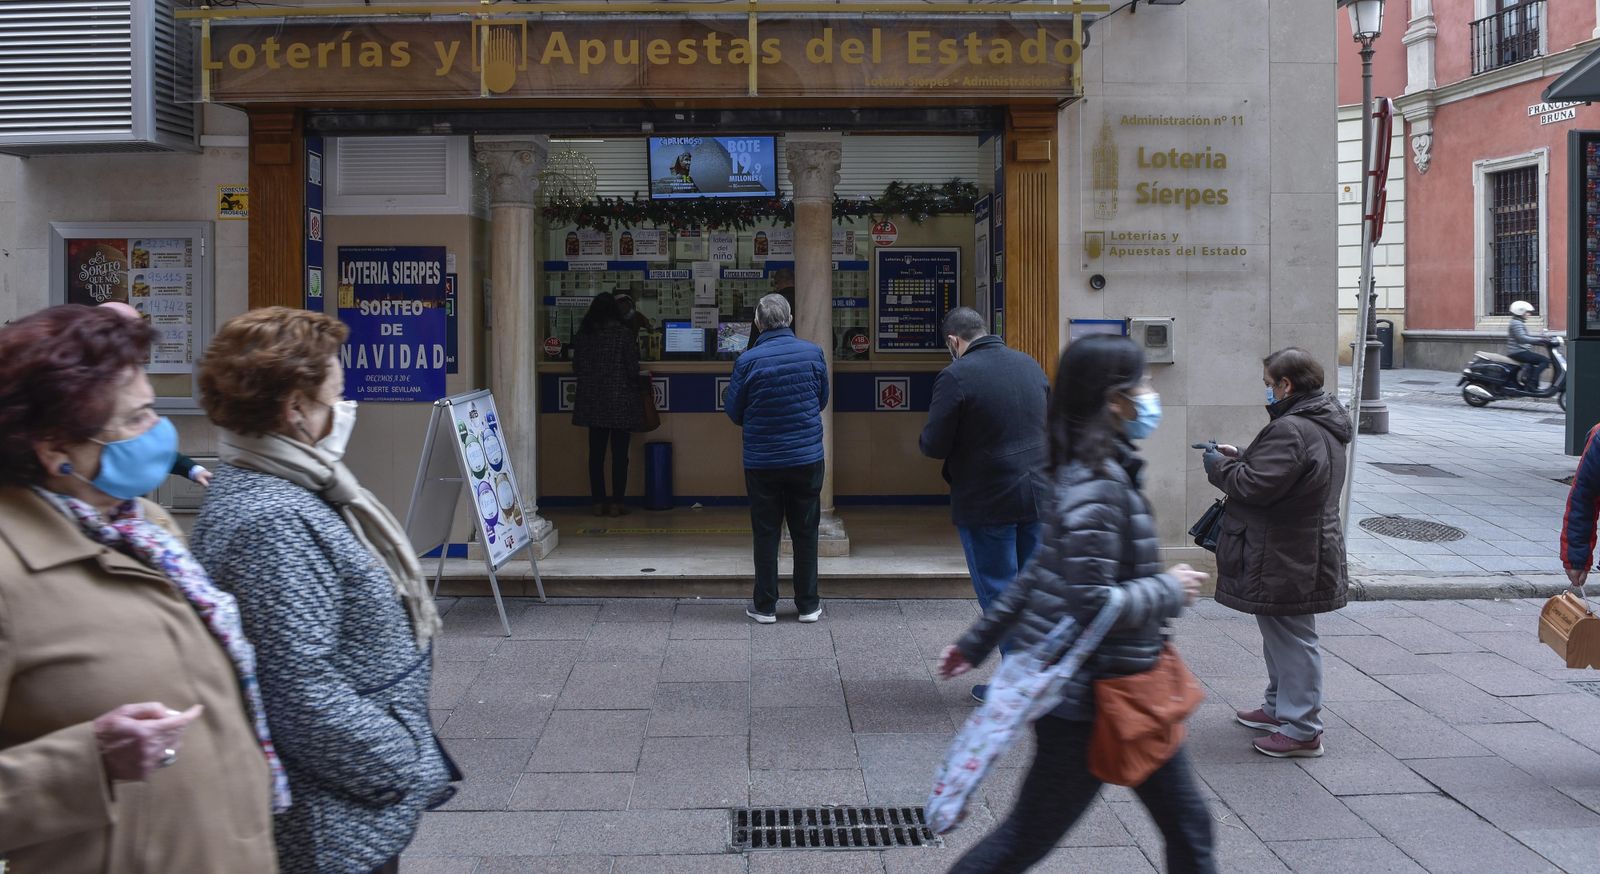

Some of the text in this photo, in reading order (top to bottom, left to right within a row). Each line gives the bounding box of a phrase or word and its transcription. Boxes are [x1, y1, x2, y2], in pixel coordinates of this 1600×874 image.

[202, 28, 1081, 75] Loterías y Apuestas del Estado
[1120, 115, 1210, 126] Administración
[1231, 115, 1244, 126] 11
[1541, 110, 1574, 123] BRUNA
[728, 140, 760, 153] BOTE
[1137, 146, 1227, 169] Loteria
[1111, 231, 1179, 242] Loterías y
[713, 251, 732, 260] niño
[1109, 246, 1247, 258] Apuestas del Estado
[79, 261, 120, 281] SORTEO
[342, 261, 440, 284] LOTERIA SIERPES
[89, 276, 104, 284] QUE
[85, 283, 112, 302] UNE
[360, 300, 423, 316] SORTEO
[381, 324, 403, 335] DE
[341, 344, 444, 369] NAVIDAD
